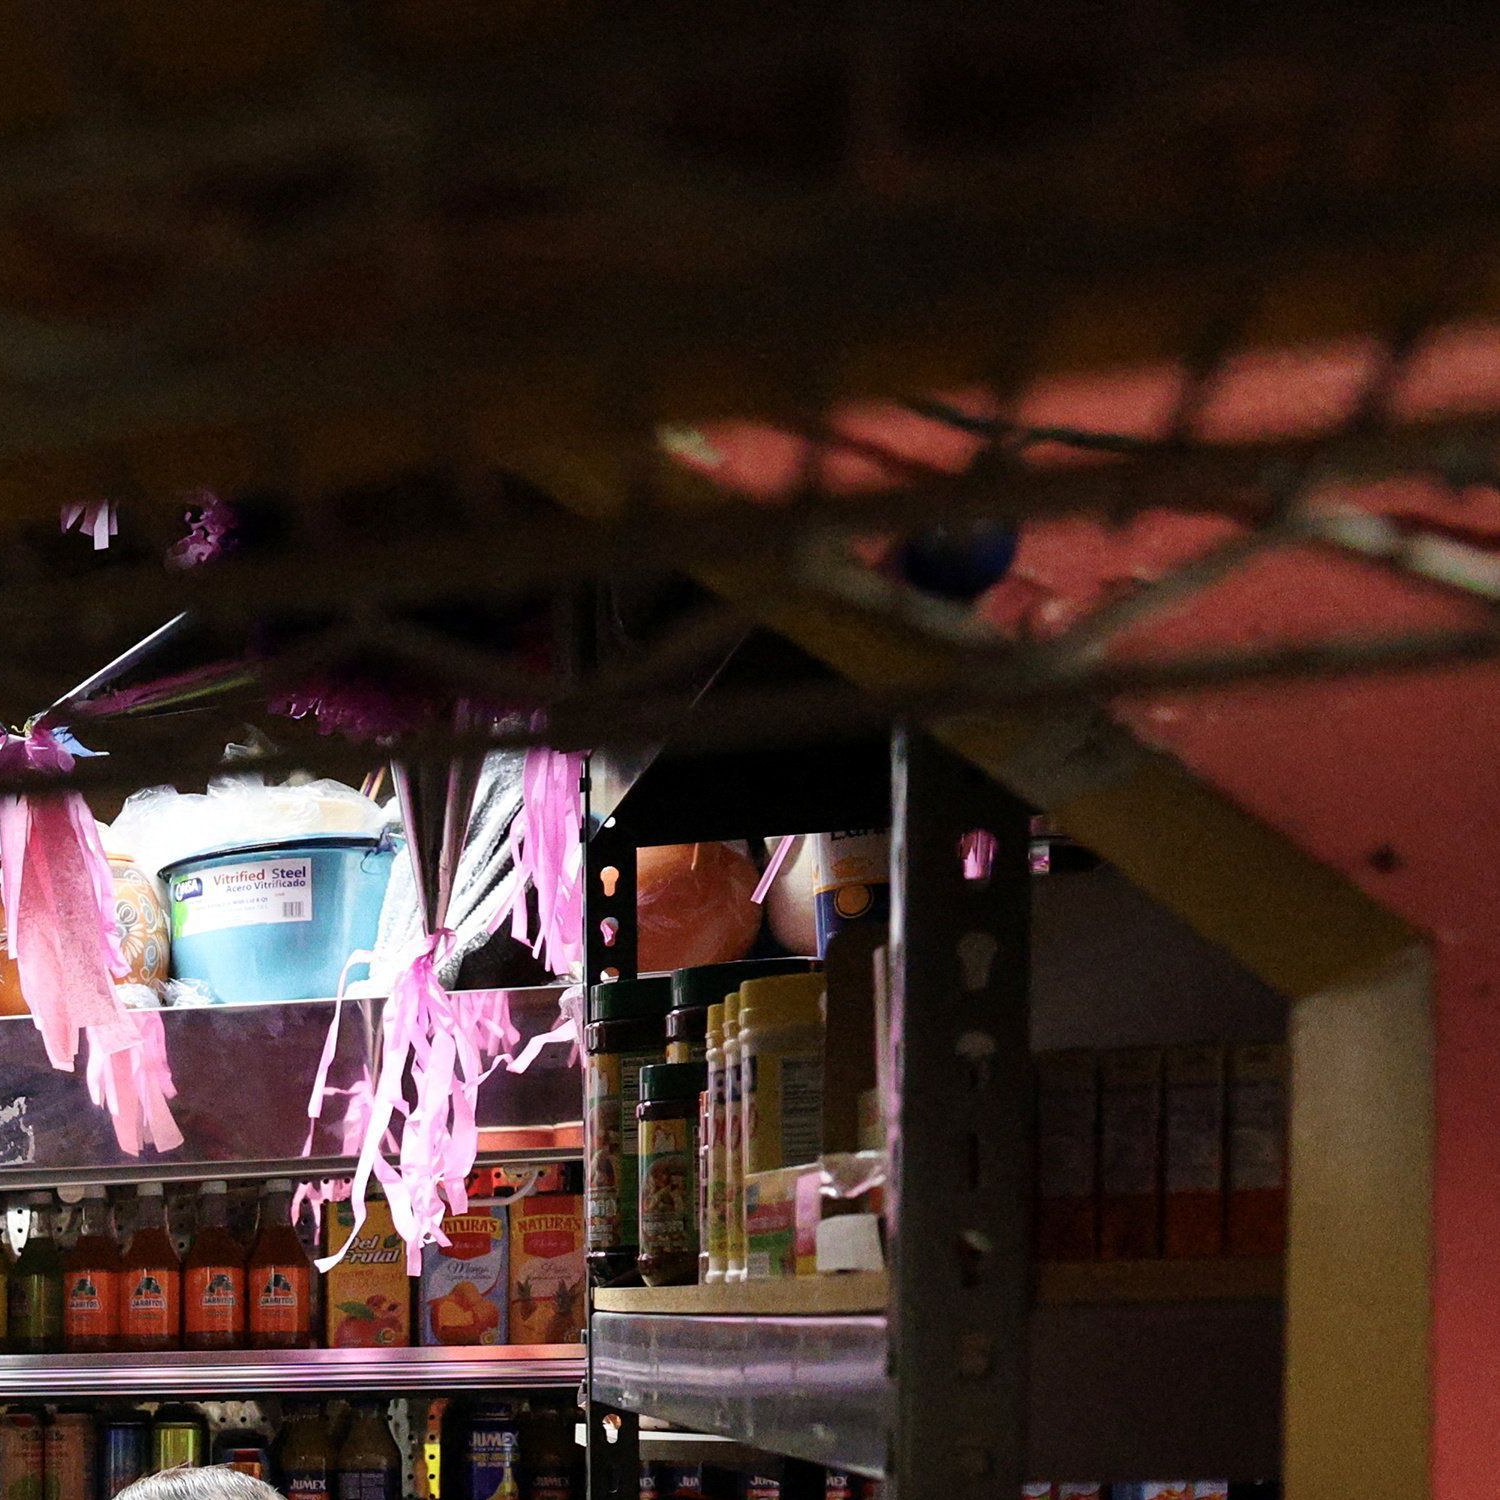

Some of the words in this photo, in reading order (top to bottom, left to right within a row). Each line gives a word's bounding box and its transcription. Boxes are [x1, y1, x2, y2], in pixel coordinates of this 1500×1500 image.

[213, 869, 265, 886] Vitrified
[272, 866, 306, 879] Steel
[226, 883, 252, 893] Acero
[254, 878, 306, 890] Vitrificado
[443, 1217, 498, 1234] ATURA'S
[132, 1300, 164, 1308] JARRITOS
[468, 1431, 519, 1447] JUMEX
[290, 1478, 327, 1491] JUMEX
